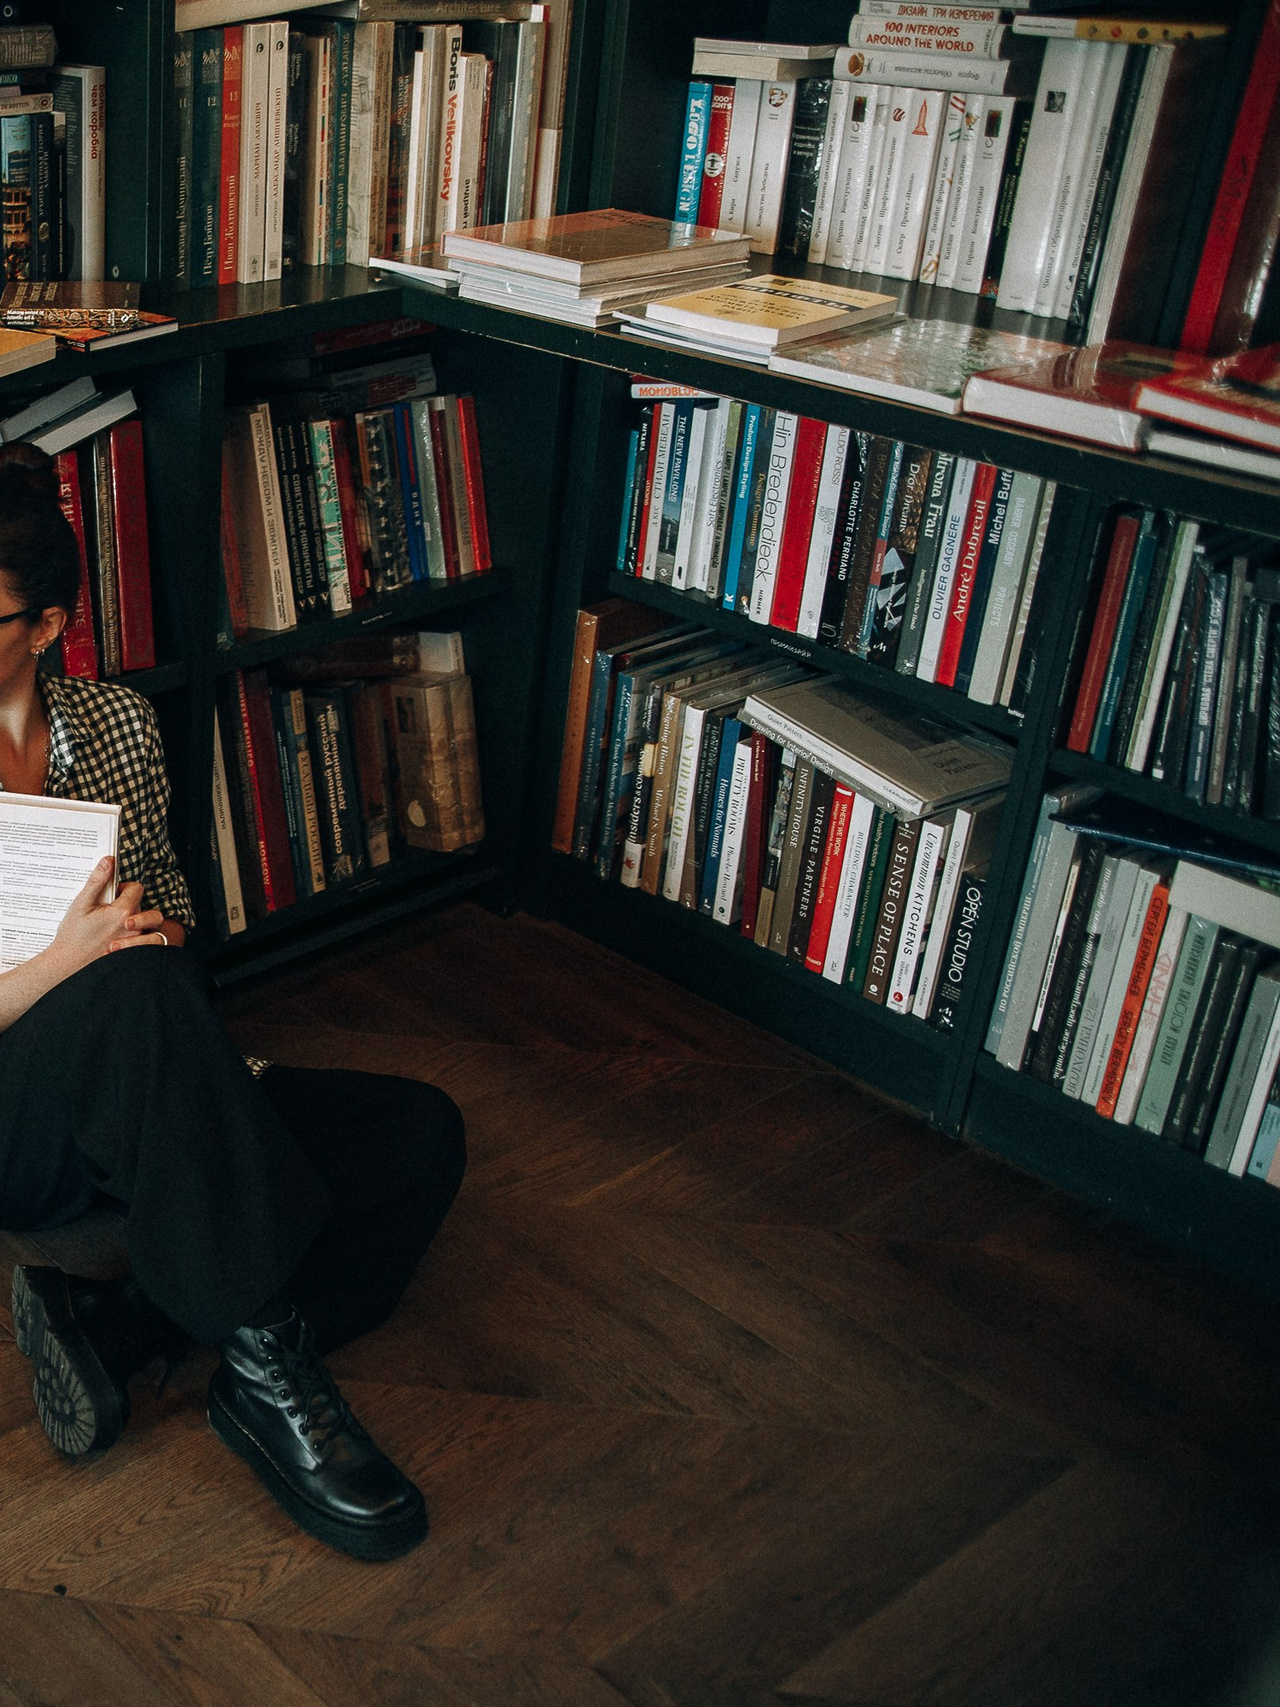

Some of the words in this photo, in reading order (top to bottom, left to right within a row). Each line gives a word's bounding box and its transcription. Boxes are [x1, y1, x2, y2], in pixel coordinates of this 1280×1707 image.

[866, 34, 910, 46] AROUND
[915, 38, 932, 48] THE
[936, 39, 973, 52] WORLD
[885, 22, 902, 32] 100
[905, 24, 960, 37] INTERIORS
[448, 37, 461, 92] Boris
[91, 84, 99, 108] чем
[207, 96, 217, 107] 12
[229, 91, 239, 101] 13
[89, 111, 99, 160] коробка
[440, 94, 459, 202] Velikovsky
[176, 156, 186, 220] Каминский
[225, 175, 236, 240] Жолтовский
[204, 204, 213, 247] Бойцов
[836, 220, 844, 243] Гордон
[1086, 214, 1100, 254] Искусство
[224, 242, 235, 271] Иван
[639, 386, 699, 397] MONOBLOC
[677, 435, 685, 452] NEW
[679, 415, 687, 434] THE
[774, 416, 792, 449] Hin
[670, 452, 682, 502] PAVILIONS
[906, 463, 920, 490] Dror
[292, 474, 307, 528] СОВЕТСКИЕ
[755, 454, 788, 583] Bredendieck
[847, 481, 860, 528] CHARLOTTE
[899, 494, 913, 533] Dreams
[298, 528, 314, 589] МОНУМЕНТЫ
[838, 529, 852, 581] PERRIAND
[932, 578, 949, 620] OLIVIER
[943, 514, 961, 575] GAGNÈRE
[952, 573, 972, 622] André
[963, 500, 987, 571] Dubreuil
[749, 718, 776, 742] Drawing
[776, 733, 786, 748] for
[785, 739, 812, 760] Interior
[810, 752, 834, 775] Design
[796, 768, 809, 812] INFINITY
[790, 813, 802, 848] HOUSE
[810, 805, 825, 854] VIRGILE
[258, 841, 270, 885] MOSCOW
[887, 843, 909, 899] SENSE
[918, 832, 938, 892] Uncommon
[799, 859, 816, 918] PARTNERS
[961, 887, 981, 928] OPEN
[884, 902, 897, 923] OF
[903, 892, 924, 956] KITCHENS
[872, 922, 893, 977] PLACE
[948, 928, 971, 982] STUDIO
